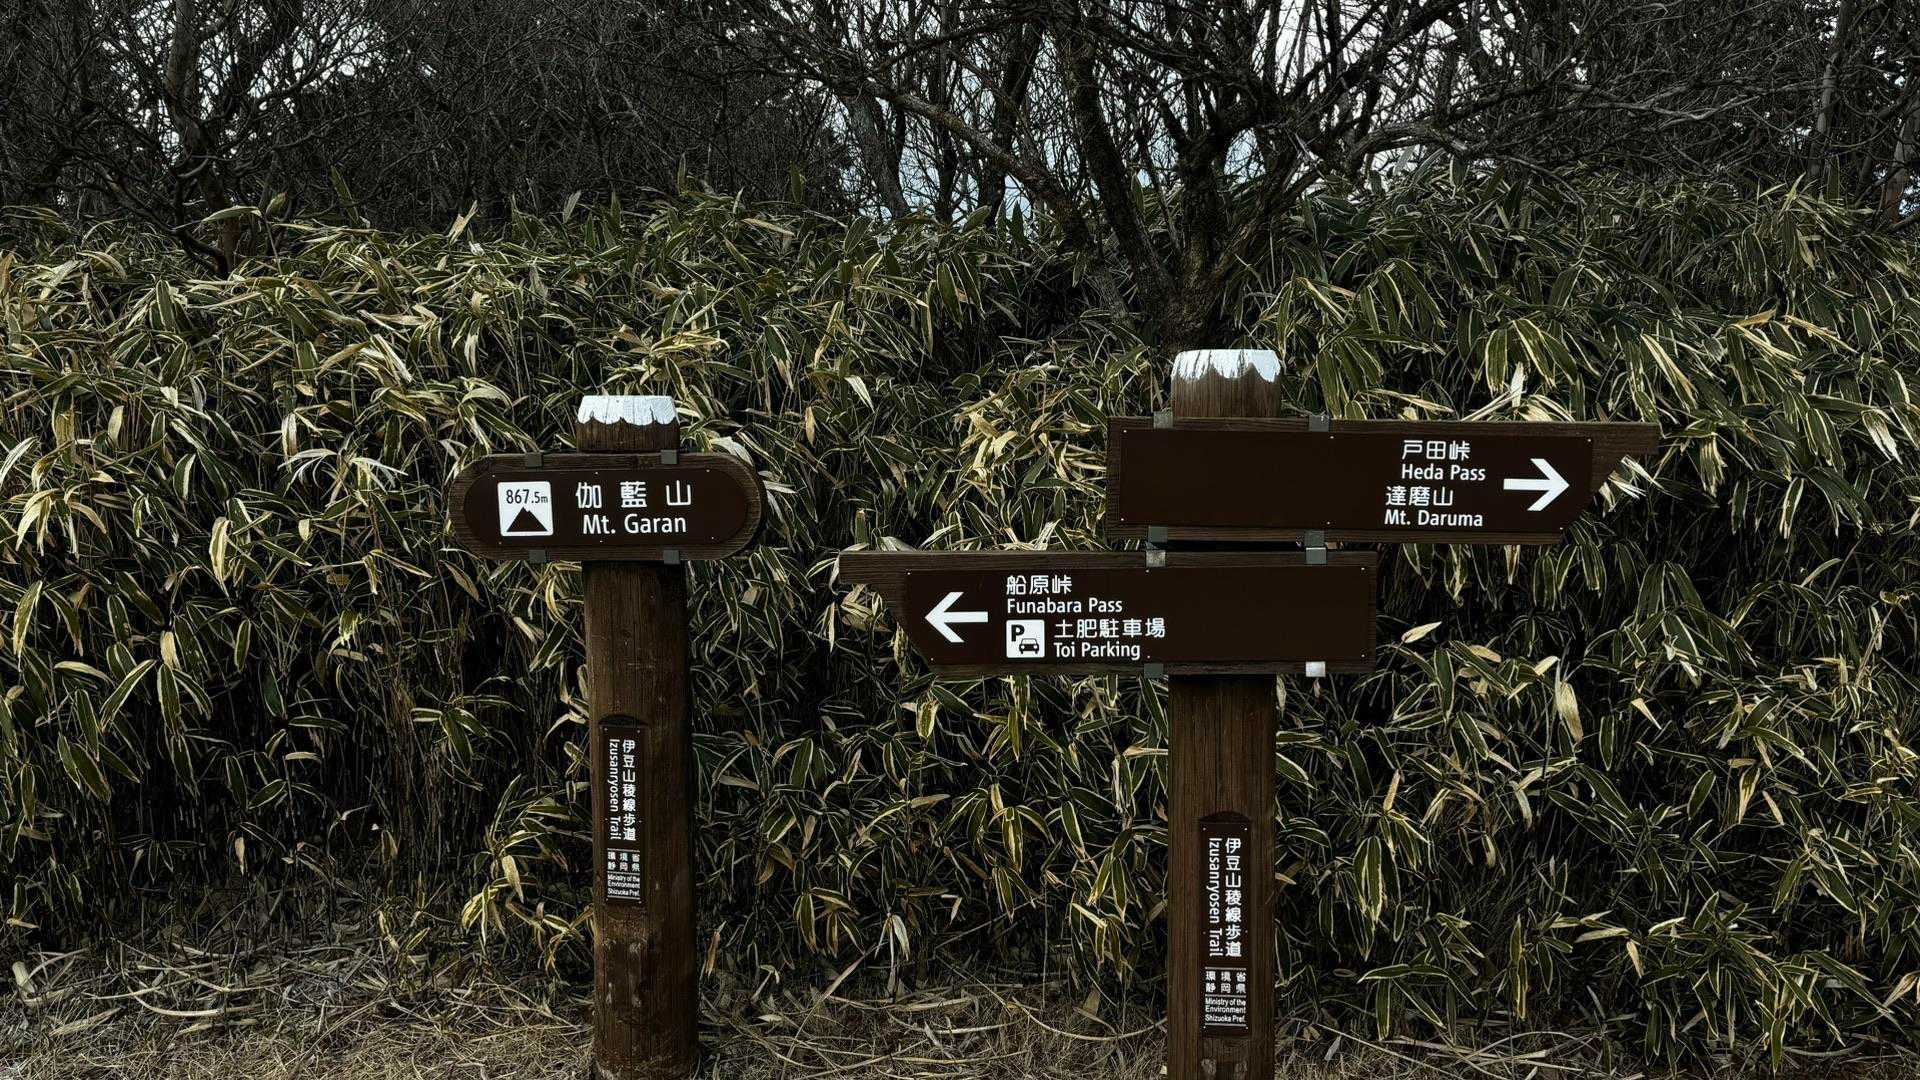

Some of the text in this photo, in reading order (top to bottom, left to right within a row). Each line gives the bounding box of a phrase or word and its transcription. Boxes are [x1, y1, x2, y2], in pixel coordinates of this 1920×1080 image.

[1402, 440, 1470, 461] 戸田峠
[1402, 463, 1486, 481] Heda Pass
[505, 489, 549, 505] 867.5m
[576, 480, 691, 509] 伽藍山
[1385, 485, 1454, 507] 達磨山
[583, 513, 687, 535] Mt. Garan
[1384, 509, 1483, 527] Mt. Daruma
[1006, 574, 1072, 596] 船原峠
[1007, 597, 1122, 614] Funabara Pass
[1010, 624, 1025, 642] P
[1054, 617, 1166, 639] 土肥駐車場
[1054, 641, 1141, 661] Toi Parking
[607, 738, 622, 840] Izusanryosen Trail
[623, 739, 636, 841] 伊豆山稜線歩道
[1206, 837, 1223, 957] Izusanryosen Trail
[1225, 837, 1242, 957] 伊豆山稜線歩道
[1205, 1005, 1246, 1014] Environment
